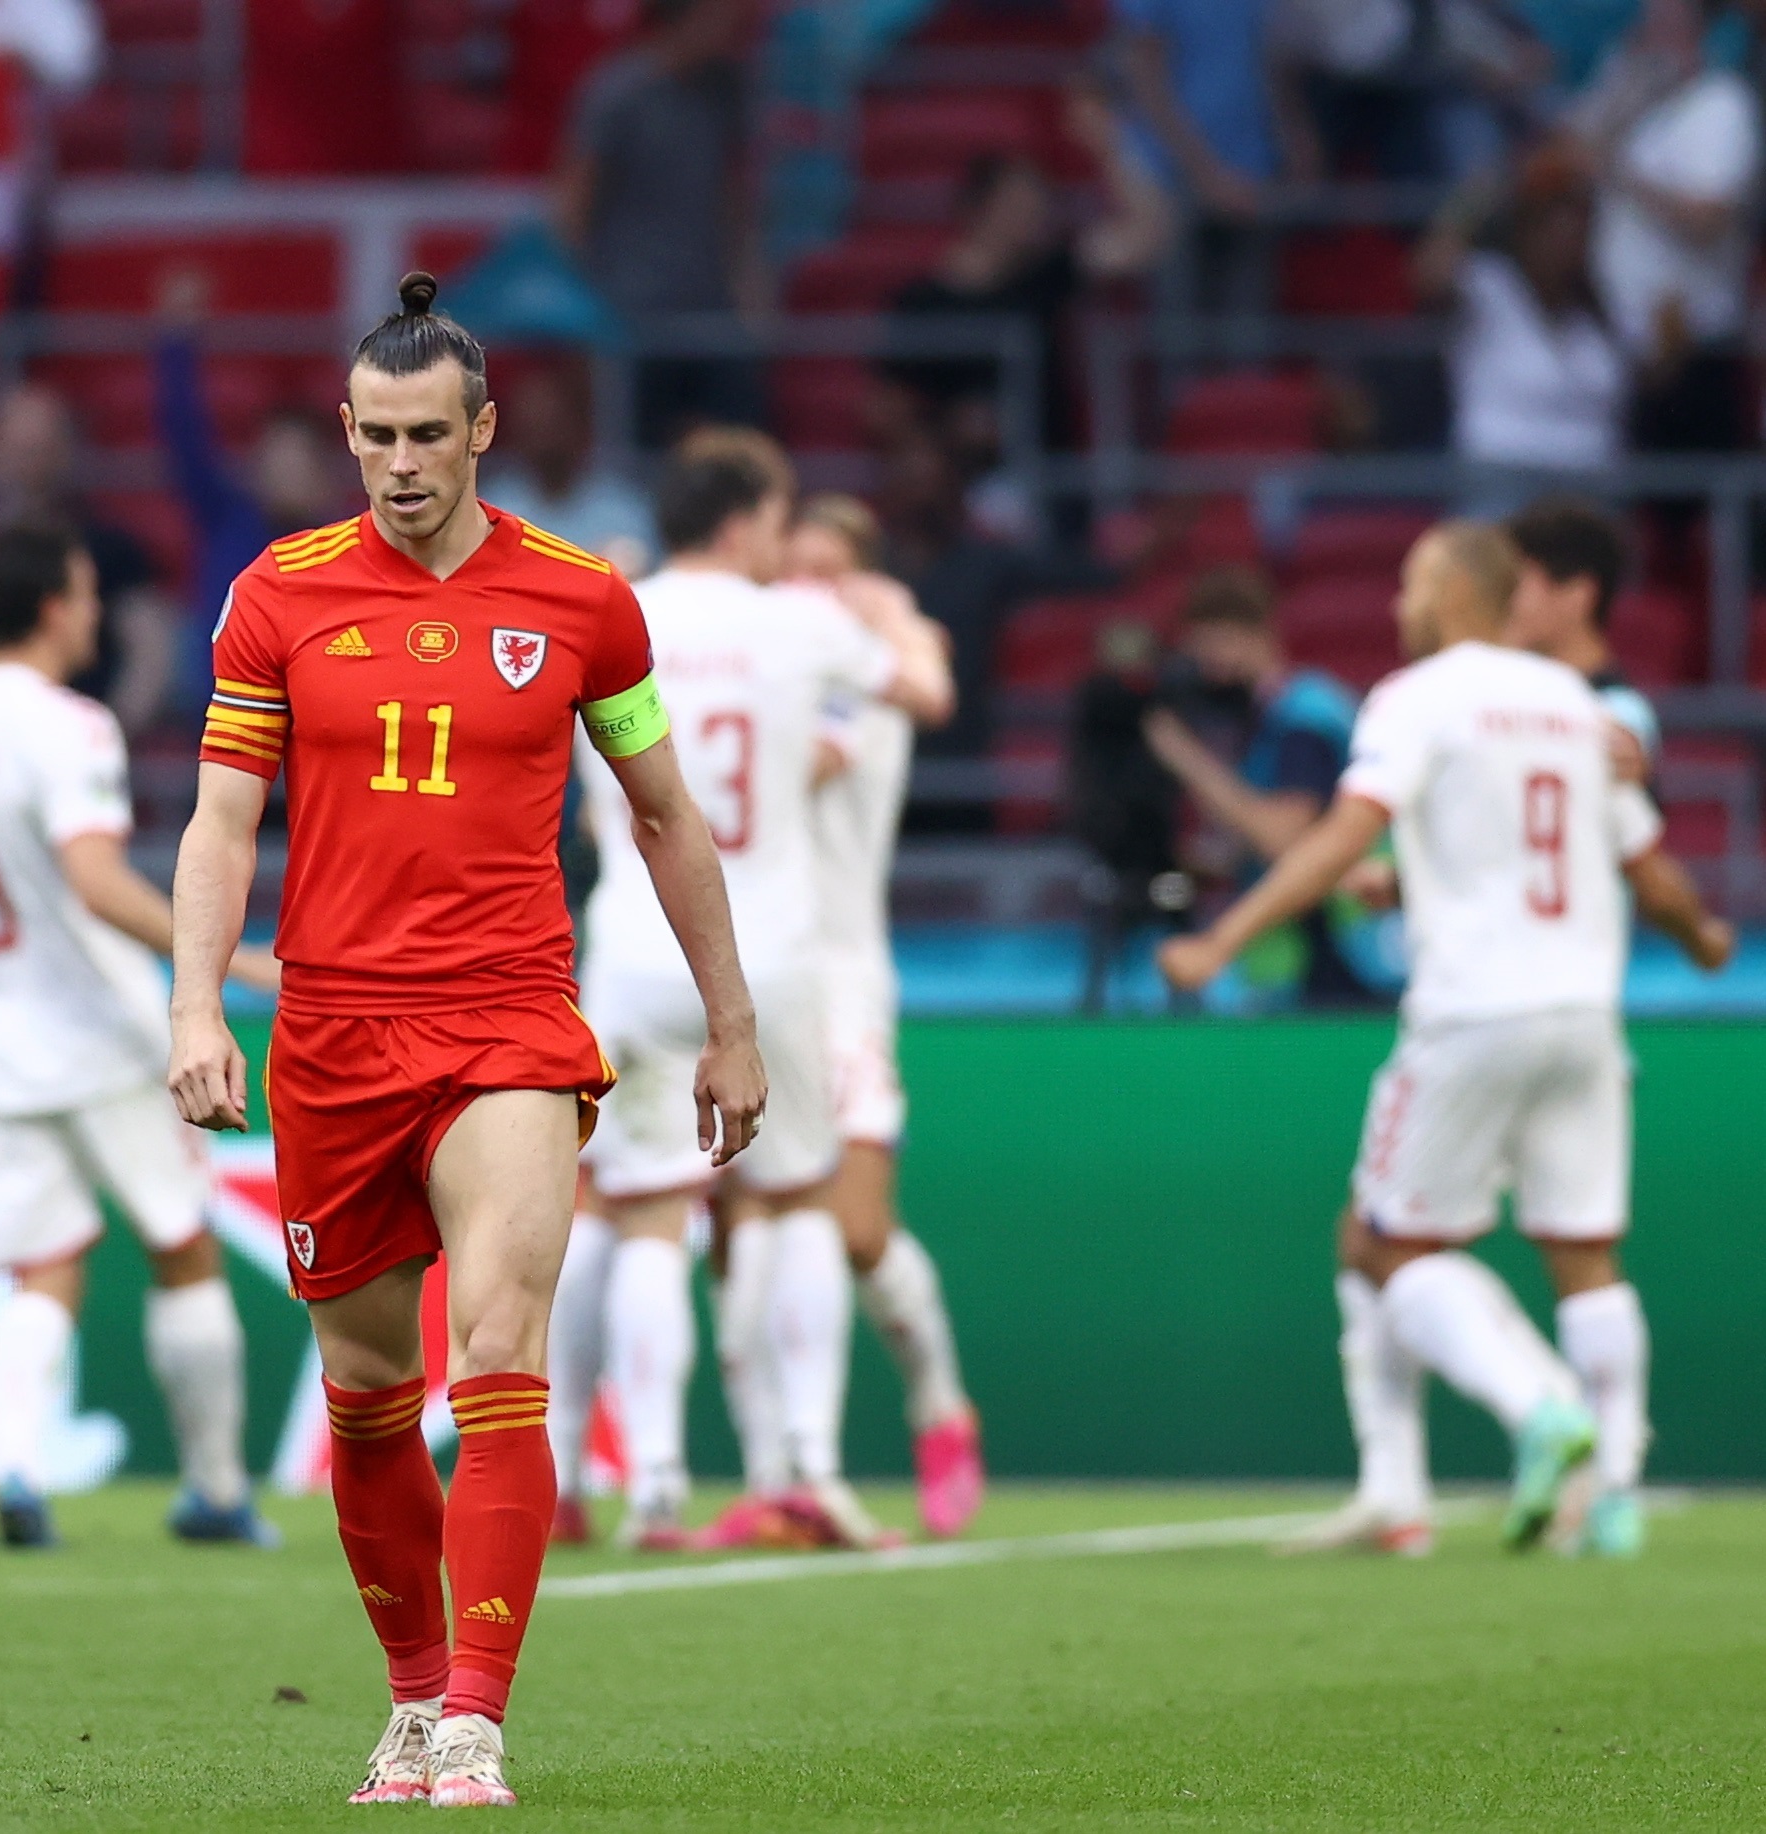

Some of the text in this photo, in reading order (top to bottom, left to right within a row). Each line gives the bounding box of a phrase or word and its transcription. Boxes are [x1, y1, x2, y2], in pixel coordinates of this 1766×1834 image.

[324, 644, 372, 657] adidas
[370, 701, 457, 797] 11
[699, 708, 758, 855] 3
[1524, 771, 1567, 919] 9
[462, 1610, 516, 1625] adidas
